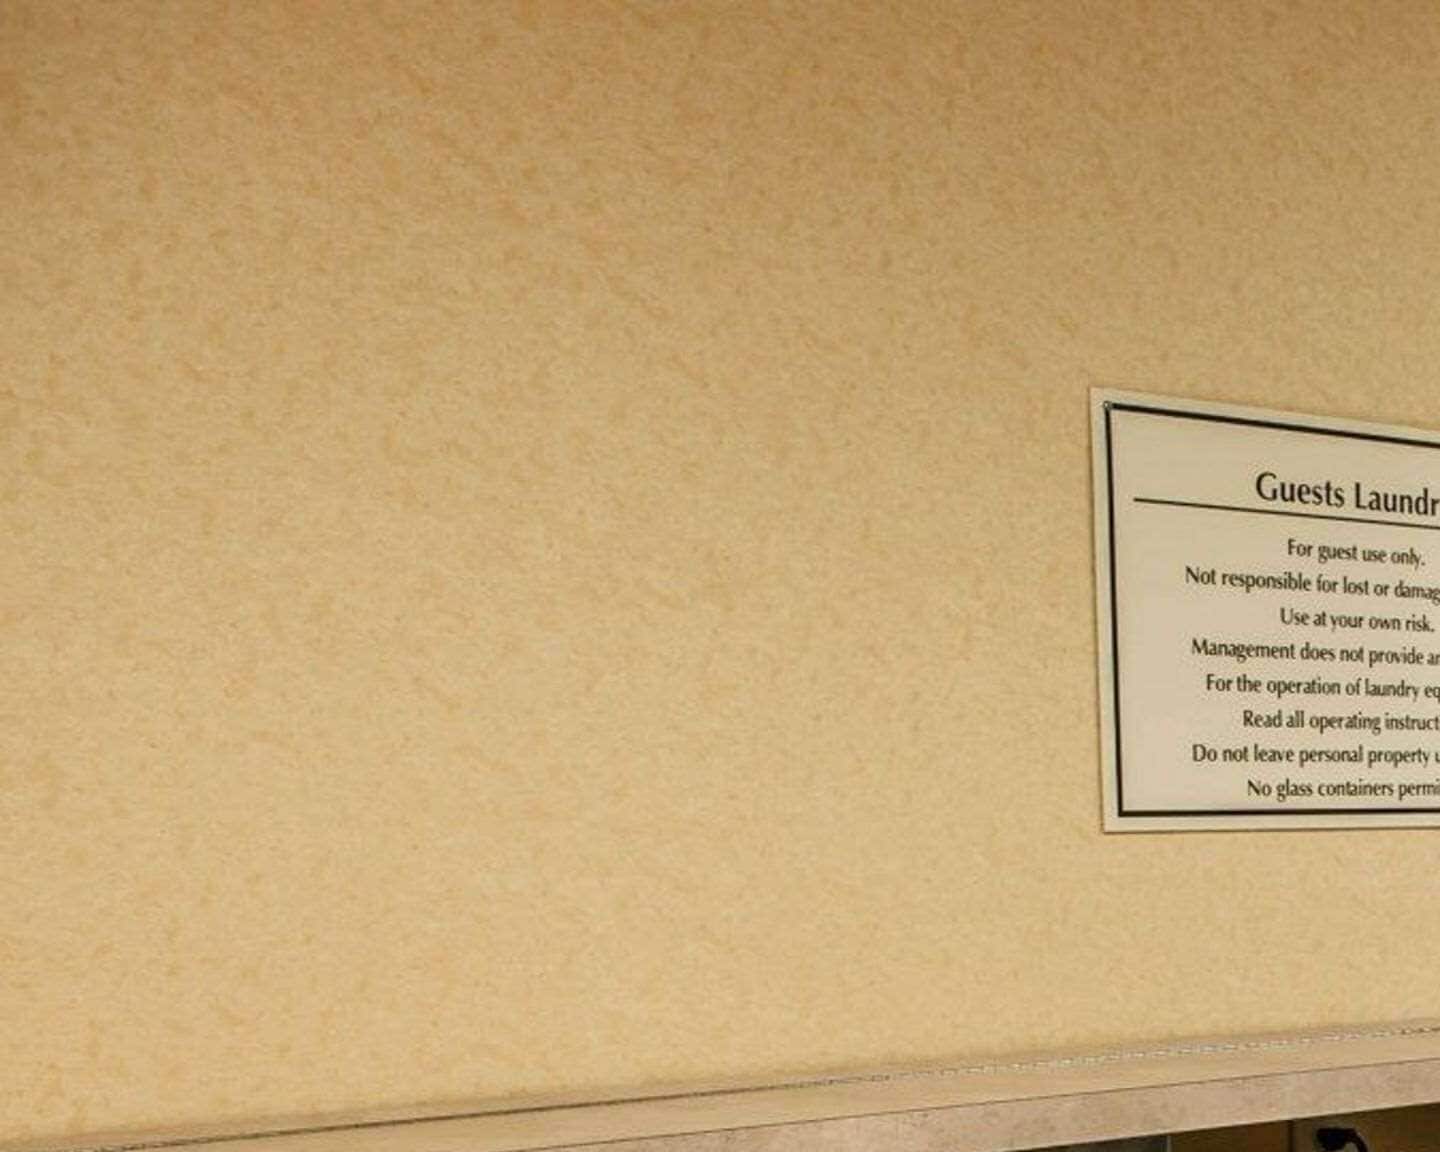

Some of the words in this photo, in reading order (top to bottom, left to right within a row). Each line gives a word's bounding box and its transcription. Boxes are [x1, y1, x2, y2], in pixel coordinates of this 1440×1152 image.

[1254, 471, 1345, 508] Guests
[1288, 538, 1314, 557] For
[1318, 545, 1358, 564] guest
[1362, 550, 1387, 563] use
[1390, 547, 1426, 569] only.
[1185, 566, 1216, 585] Not
[1221, 568, 1312, 594] responsible
[1316, 573, 1339, 593] for
[1342, 576, 1369, 595] lost
[1373, 584, 1390, 597] or
[1280, 607, 1310, 626] Use
[1312, 611, 1327, 627] at
[1329, 615, 1364, 632] your
[1368, 616, 1402, 631] own
[1405, 614, 1435, 633] risk.
[1192, 638, 1296, 663] Management
[1299, 641, 1336, 662] does
[1339, 646, 1364, 663] not
[1368, 646, 1424, 668] provide
[1206, 673, 1234, 692] For
[1236, 673, 1262, 693] the
[1266, 676, 1341, 699] operation
[1345, 677, 1362, 696] of
[1365, 678, 1420, 702] laundry
[1243, 709, 1283, 728] Read
[1286, 710, 1305, 728] all
[1309, 711, 1381, 736] operating
[1192, 744, 1218, 762] Do
[1222, 746, 1249, 762] not
[1254, 743, 1295, 763] leave
[1299, 744, 1364, 768] personal
[1367, 748, 1430, 768] property
[1248, 779, 1272, 797] No
[1276, 778, 1314, 802] glass
[1317, 778, 1394, 797] containers
